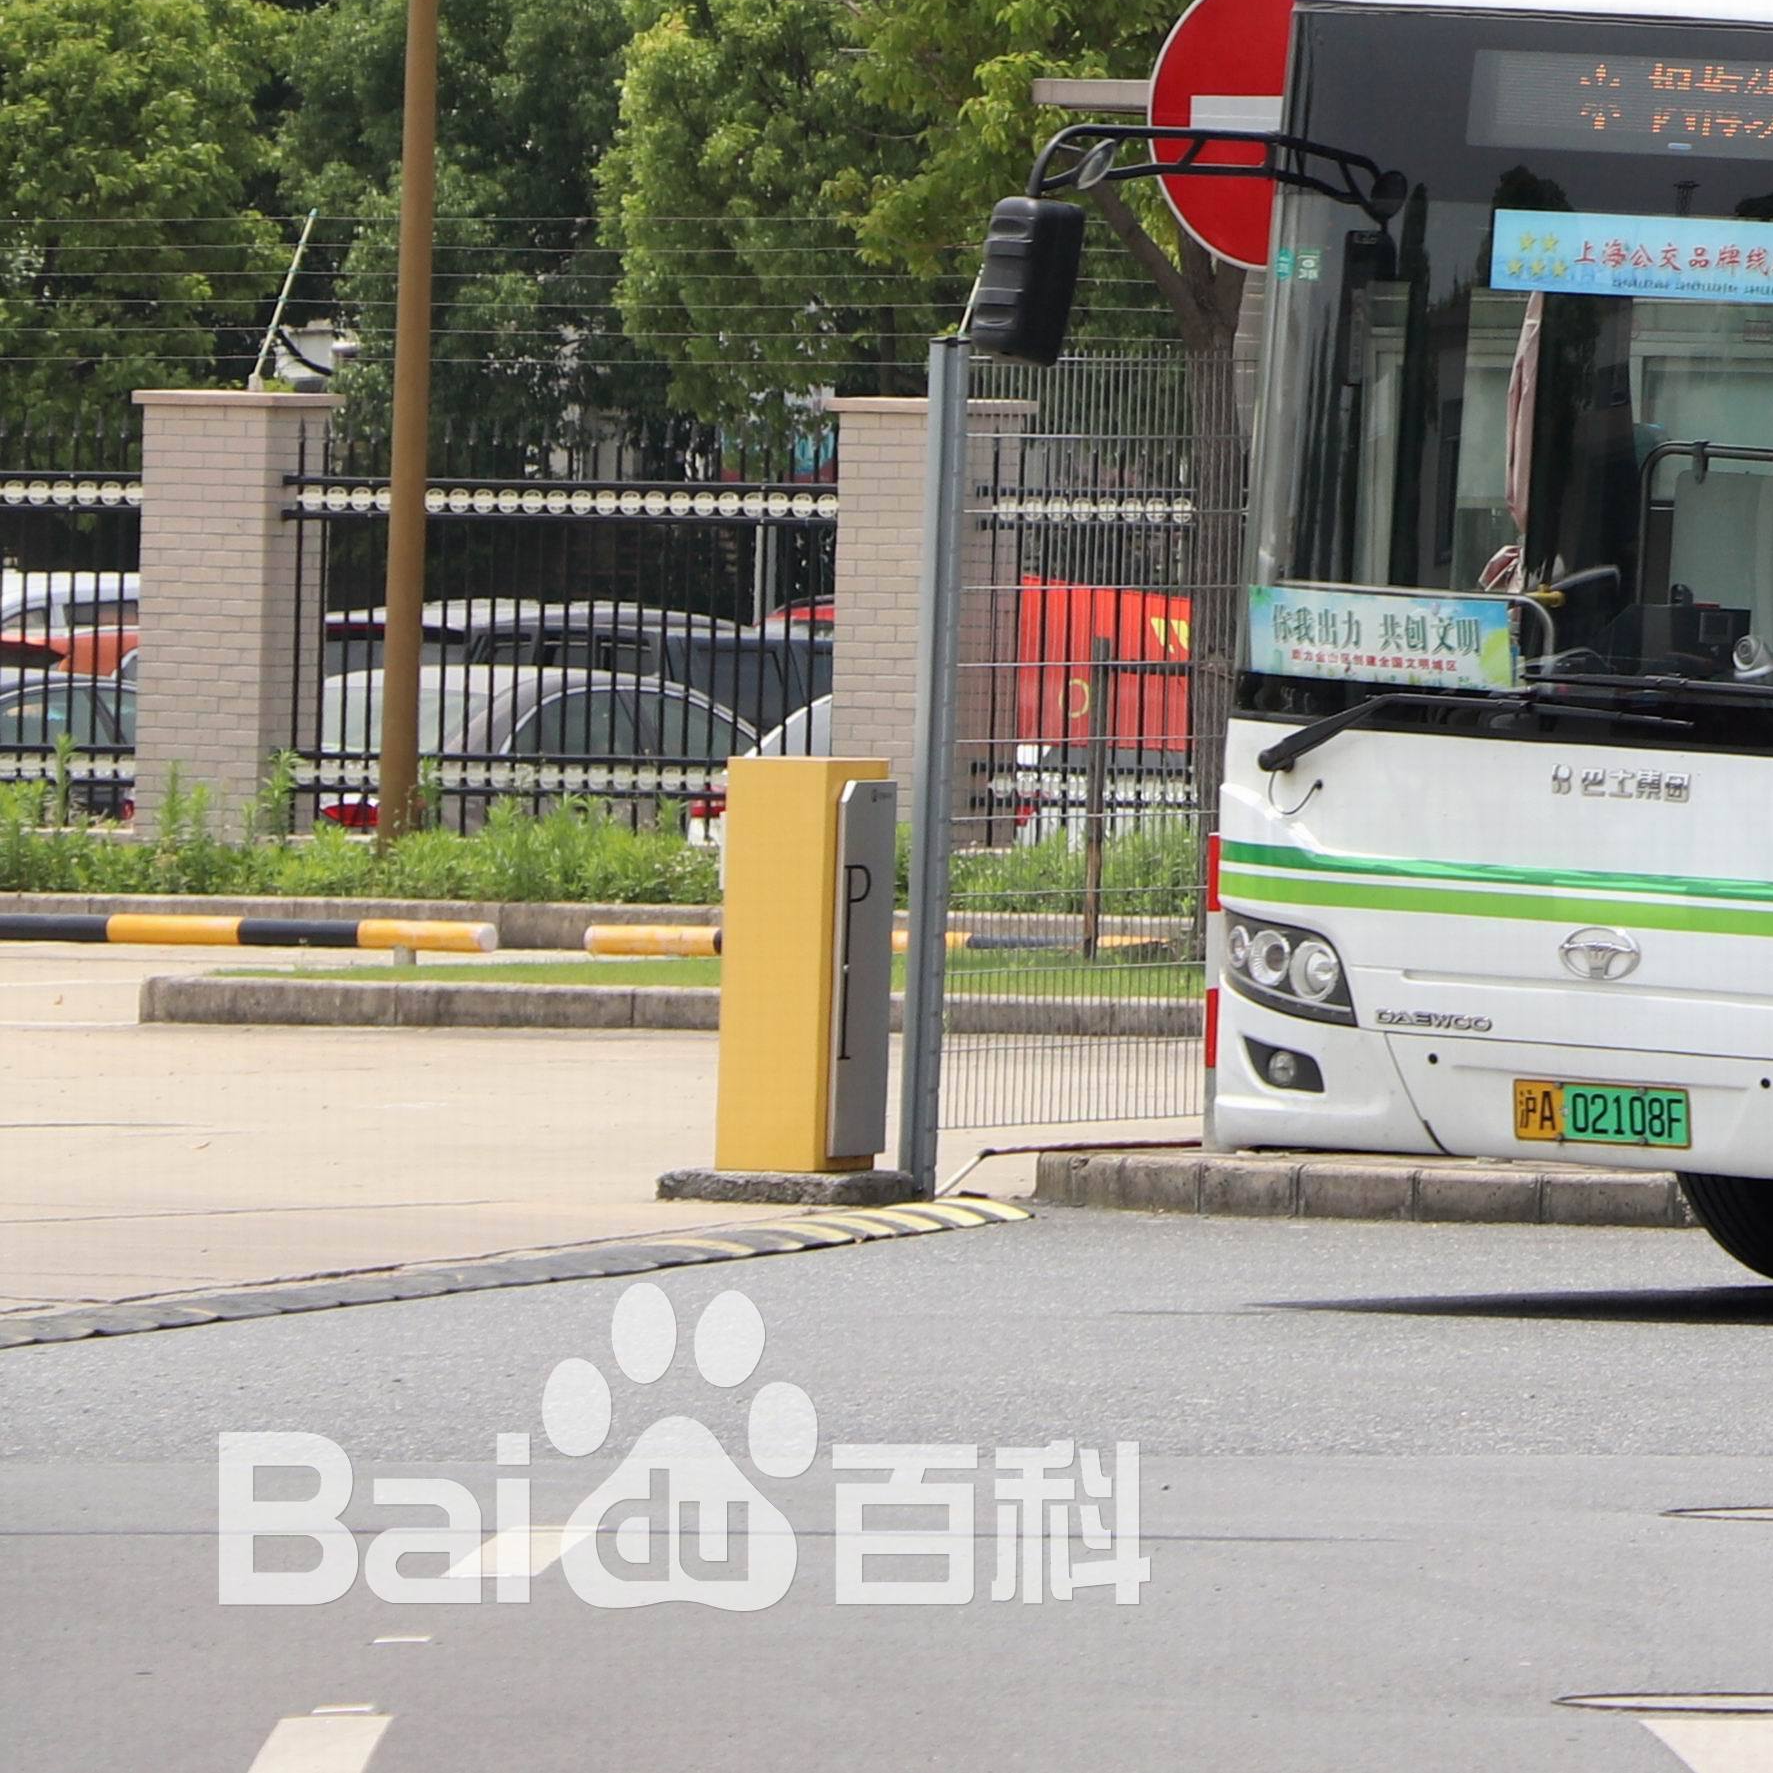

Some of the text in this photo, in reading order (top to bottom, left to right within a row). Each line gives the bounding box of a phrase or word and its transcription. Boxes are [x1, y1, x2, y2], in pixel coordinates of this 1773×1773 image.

[1272, 603, 1481, 657] 你我出力 共创文明
[1376, 1008, 1492, 1032] DAEWOO
